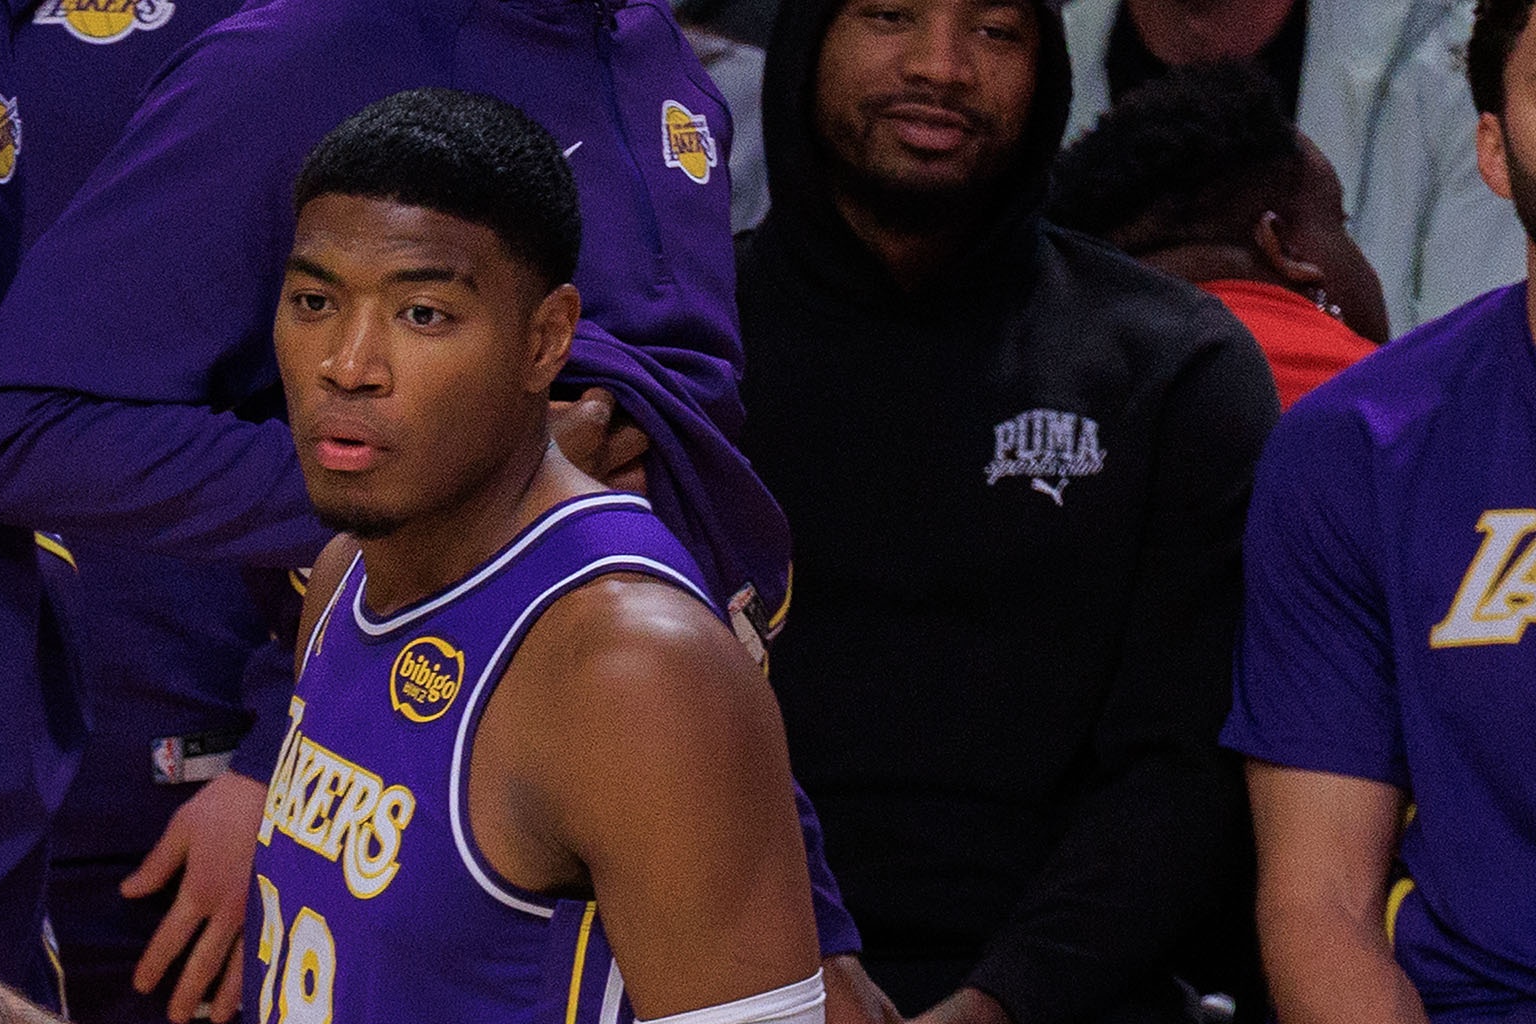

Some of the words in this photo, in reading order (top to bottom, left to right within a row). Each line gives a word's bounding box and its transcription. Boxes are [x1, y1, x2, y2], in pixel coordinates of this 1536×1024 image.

[994, 408, 1101, 465] PUMA
[399, 651, 457, 703] bibigo
[257, 695, 416, 900] LAKERS
